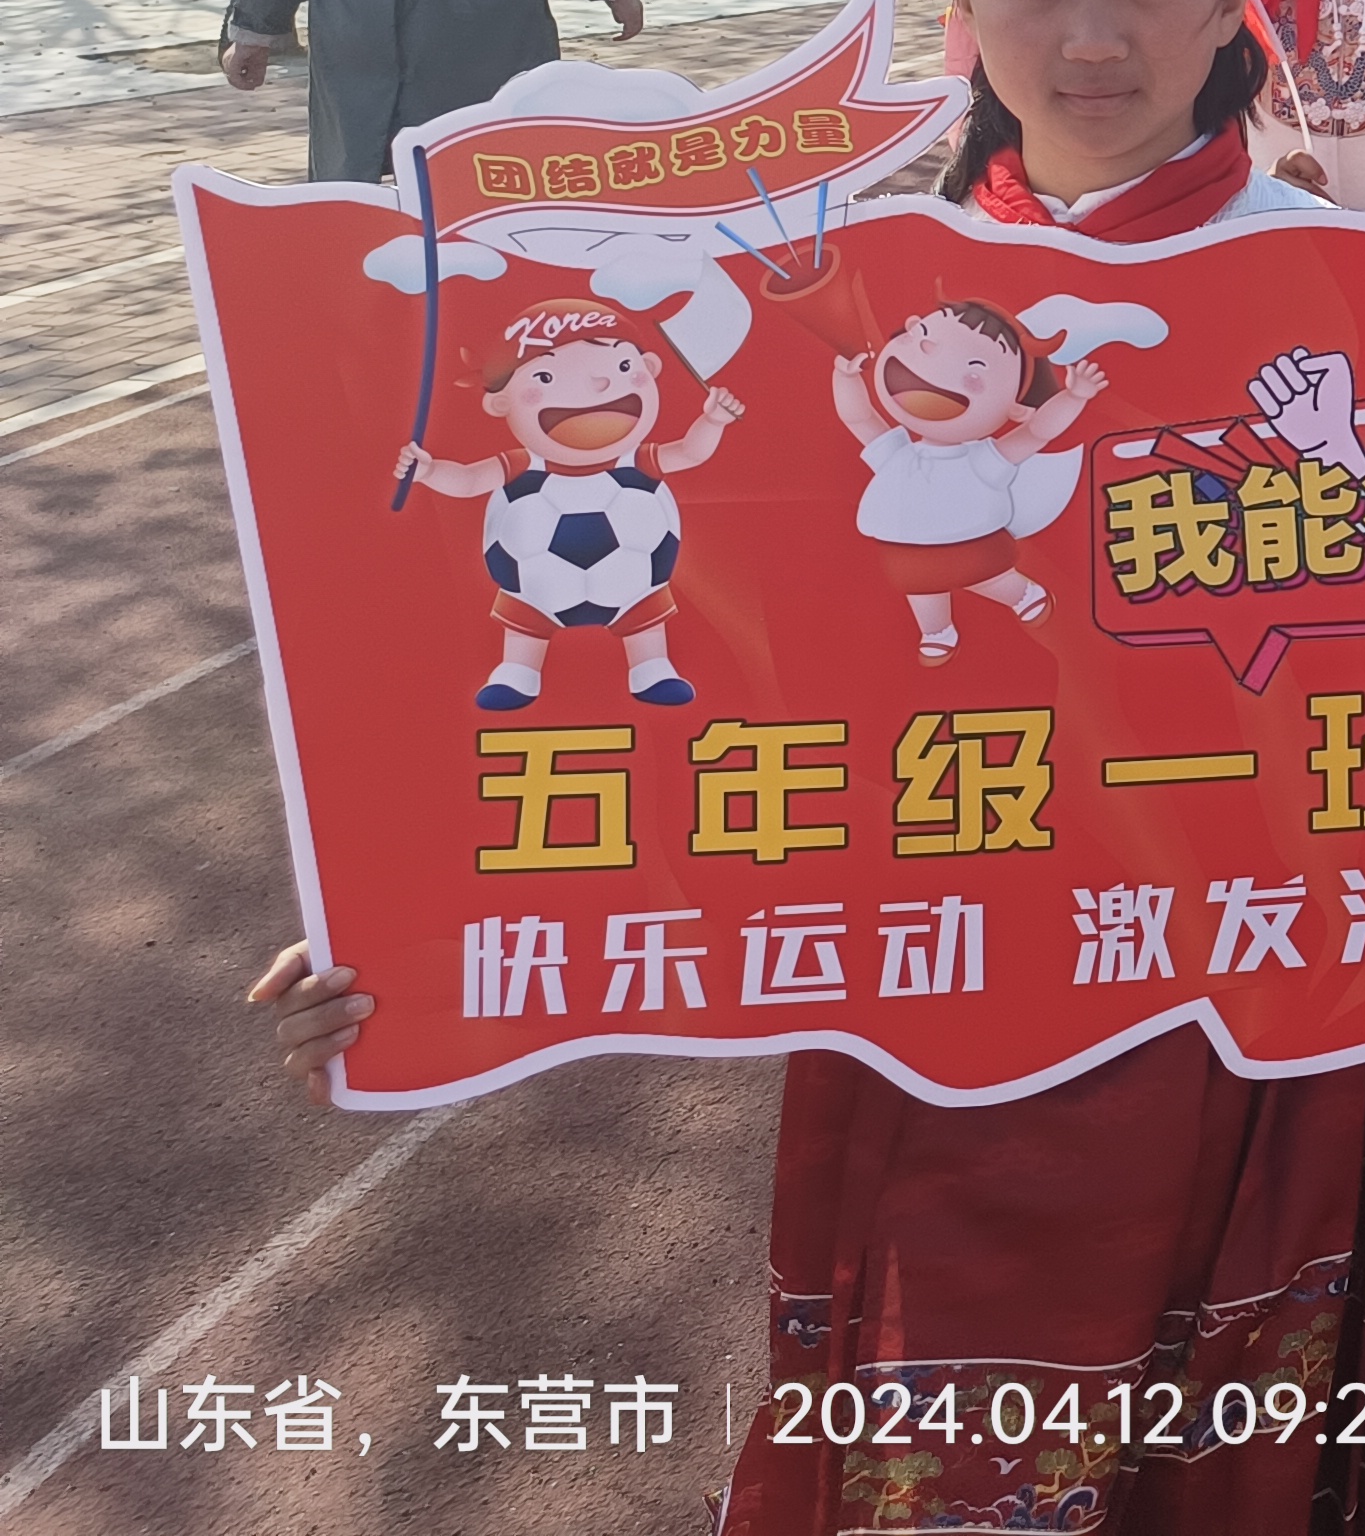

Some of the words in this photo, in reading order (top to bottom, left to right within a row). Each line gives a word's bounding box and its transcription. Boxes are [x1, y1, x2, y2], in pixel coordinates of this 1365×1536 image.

[473, 108, 854, 201] 团结就是力量
[503, 309, 618, 359] Korea
[463, 895, 985, 1018] 快乐运动
